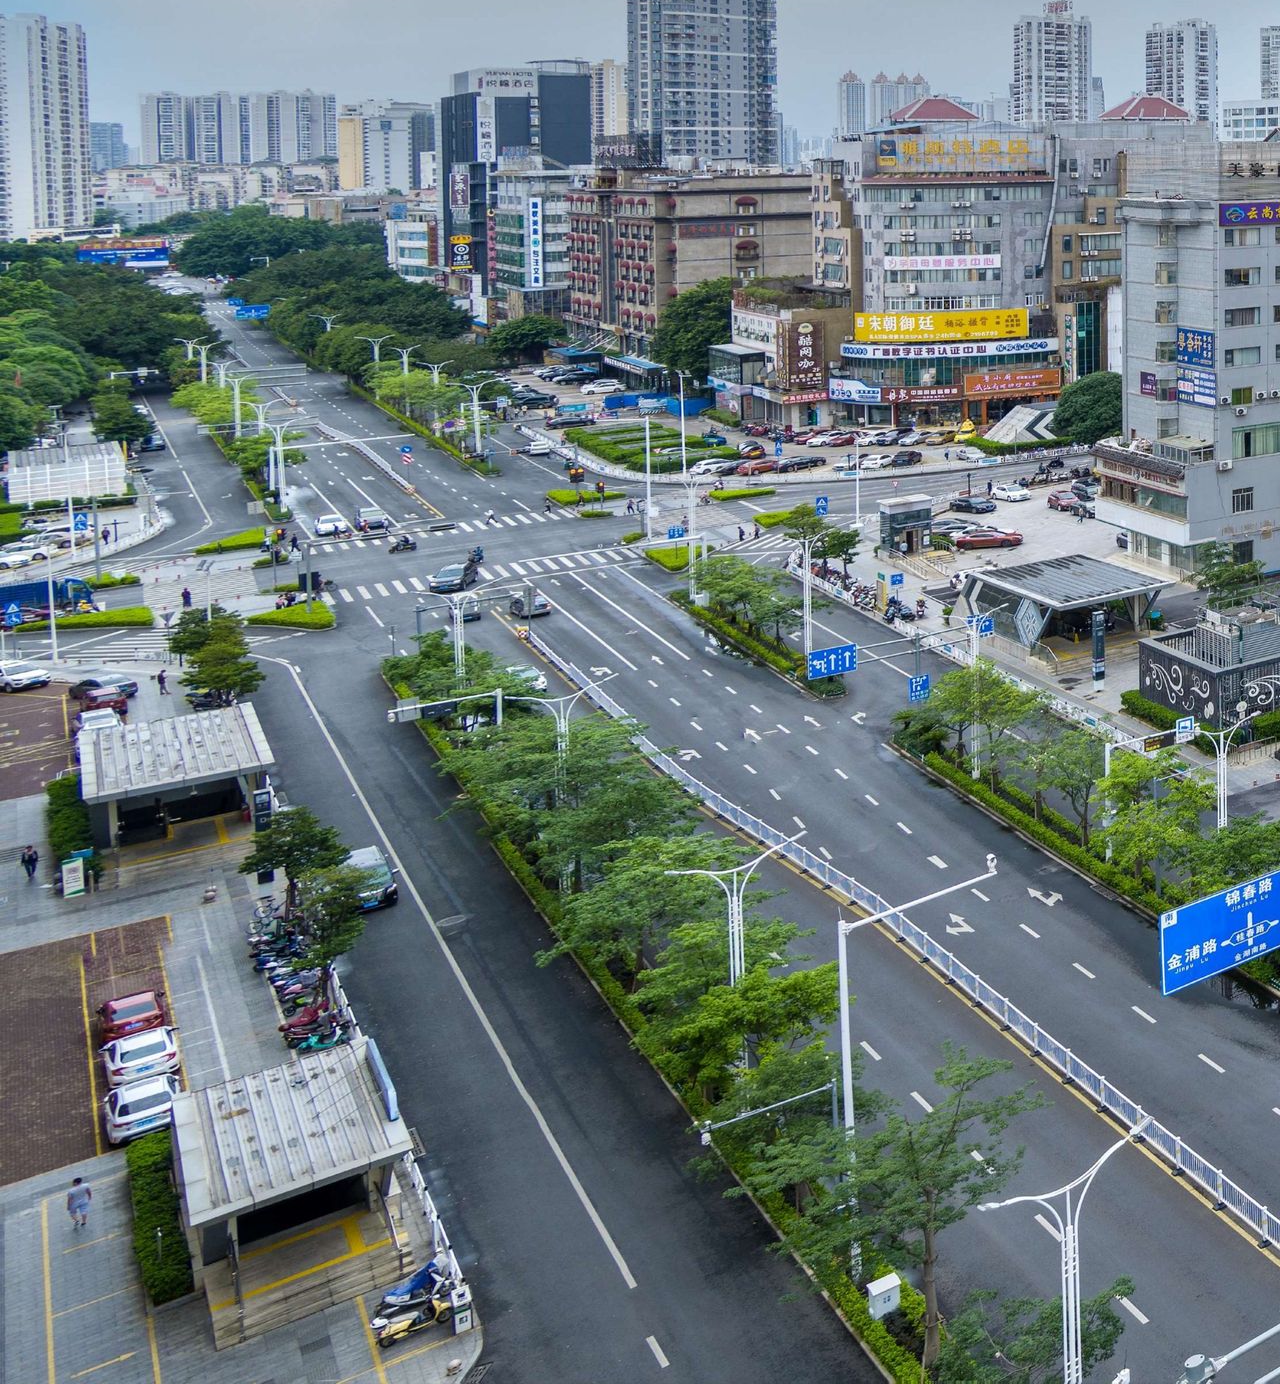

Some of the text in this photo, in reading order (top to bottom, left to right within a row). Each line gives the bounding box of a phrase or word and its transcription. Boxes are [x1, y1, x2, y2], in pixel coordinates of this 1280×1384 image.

[902, 139, 1029, 155] 雅斯特酒店
[1225, 878, 1273, 908] 锦春路
[1235, 923, 1265, 942] 桂春路
[1167, 938, 1217, 971] 金浦路
